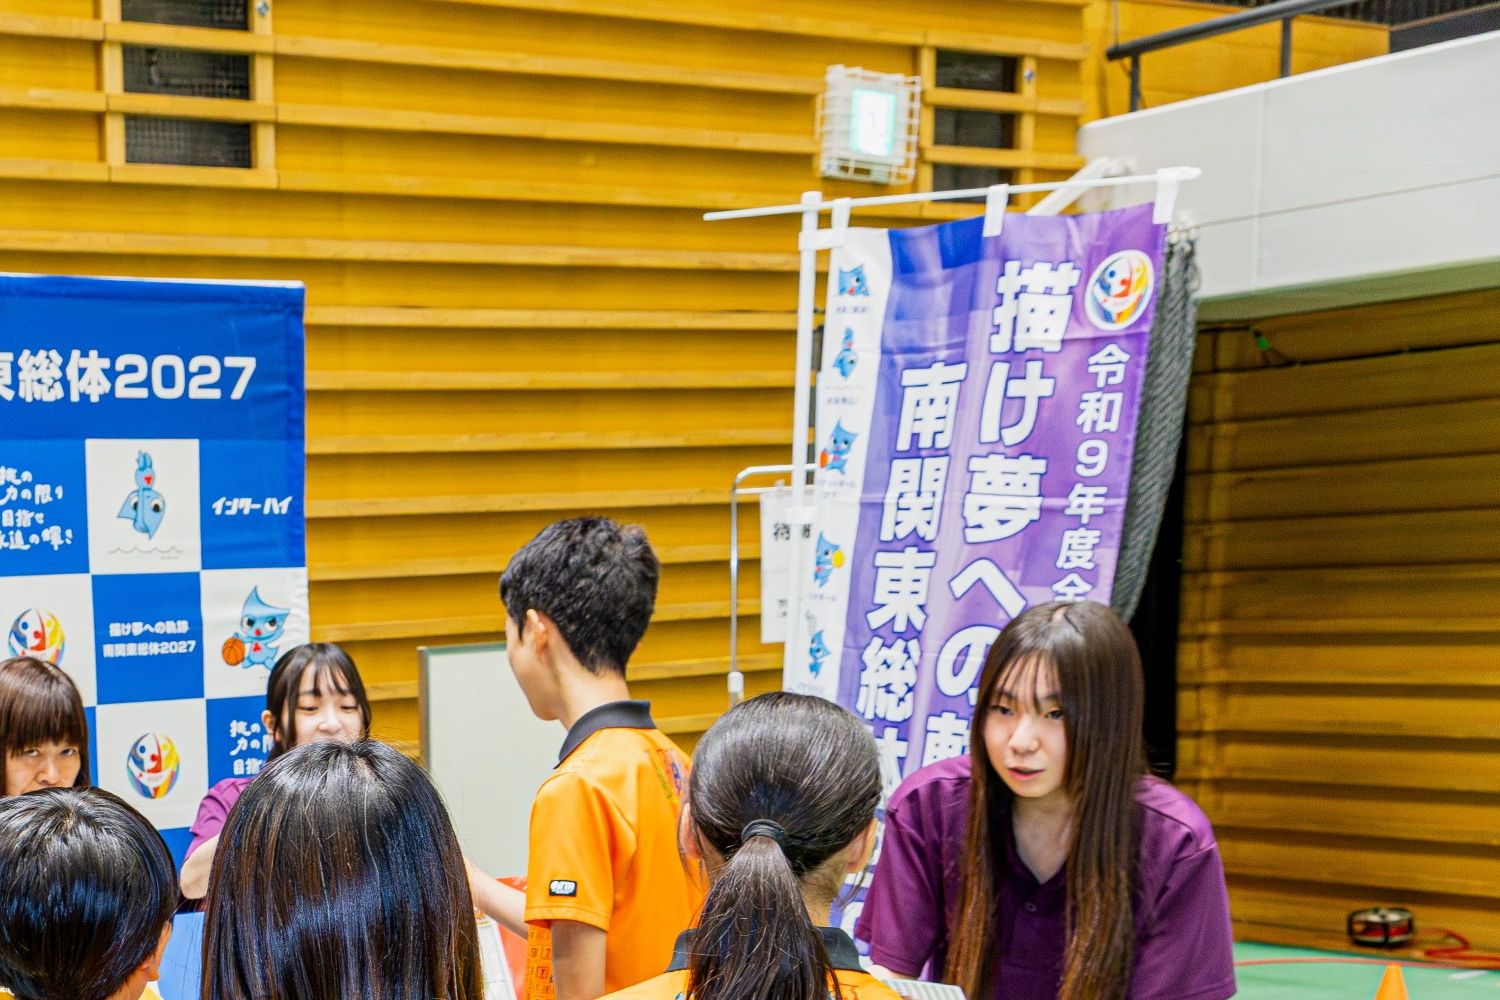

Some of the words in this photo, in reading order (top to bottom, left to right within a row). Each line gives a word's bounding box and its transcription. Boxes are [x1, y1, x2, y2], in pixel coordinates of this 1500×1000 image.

[212, 496, 293, 516] インターハイ
